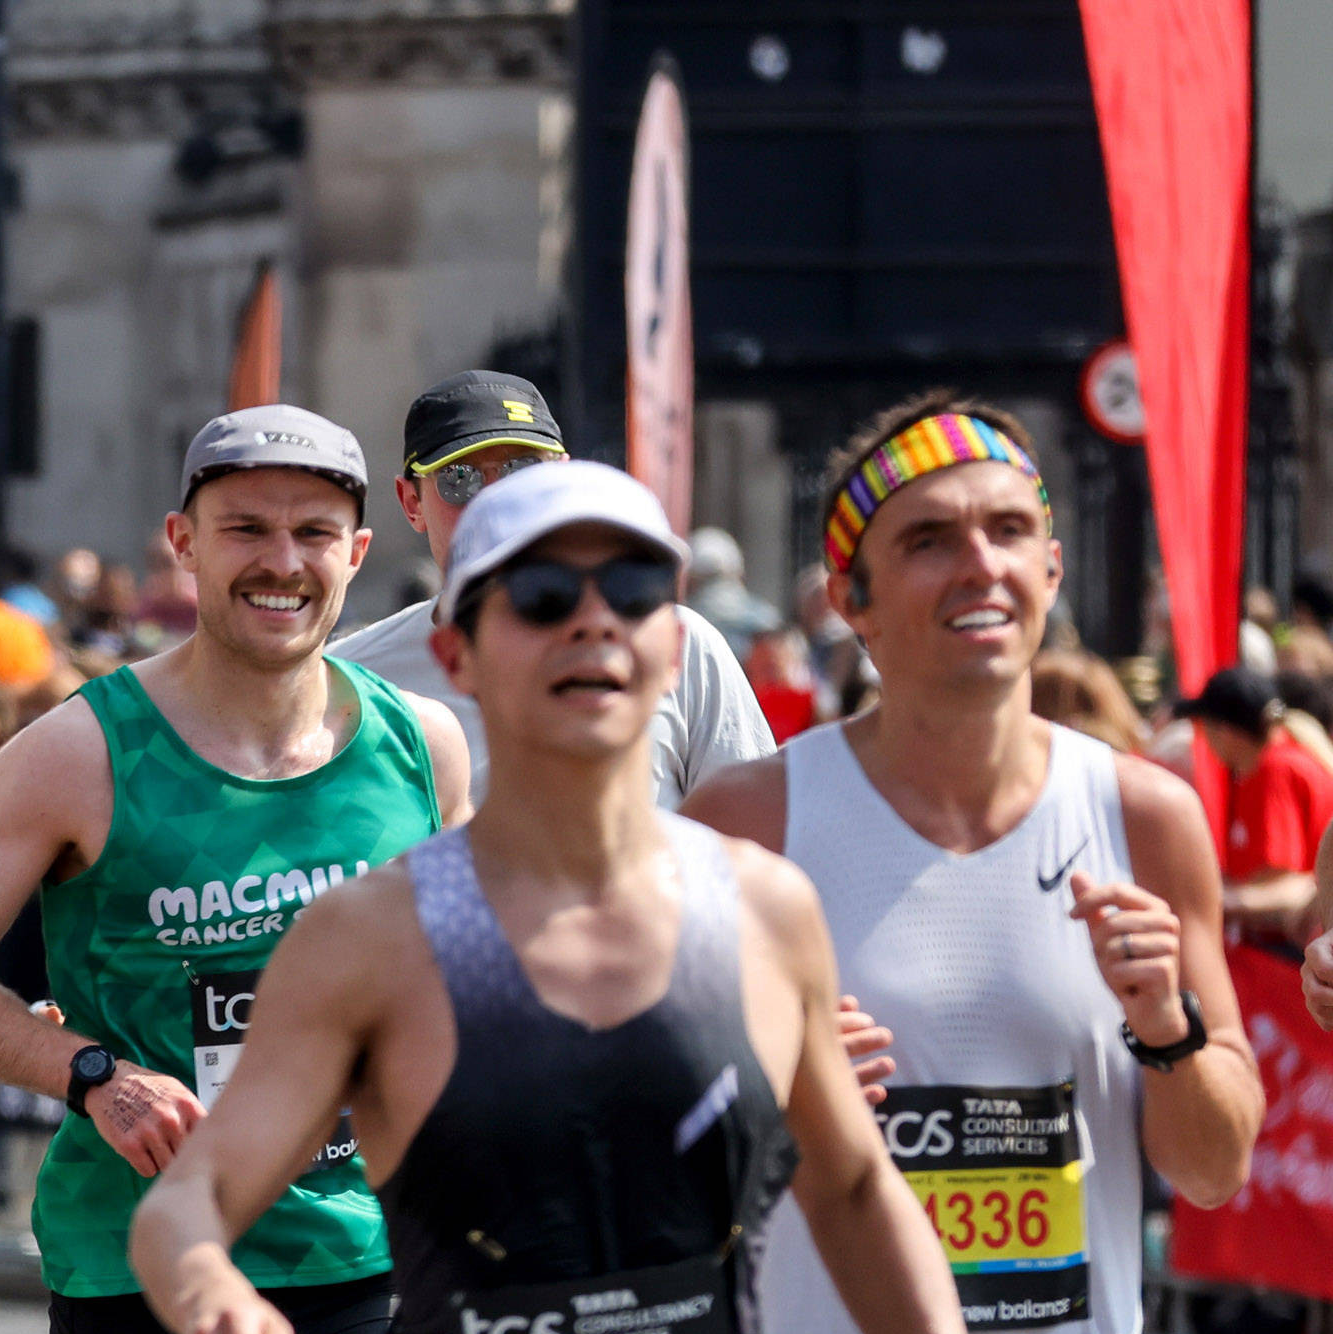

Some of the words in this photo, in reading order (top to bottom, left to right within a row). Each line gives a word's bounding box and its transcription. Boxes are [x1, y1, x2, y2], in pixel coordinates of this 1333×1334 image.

[148, 860, 393, 927] MACMI
[156, 911, 285, 946] CANCER
[206, 985, 257, 1033] tc
[962, 1098, 1023, 1116] TATA
[962, 1136, 1049, 1156] SERVICES
[963, 1303, 997, 1321] new
[998, 1298, 1071, 1322] balance
